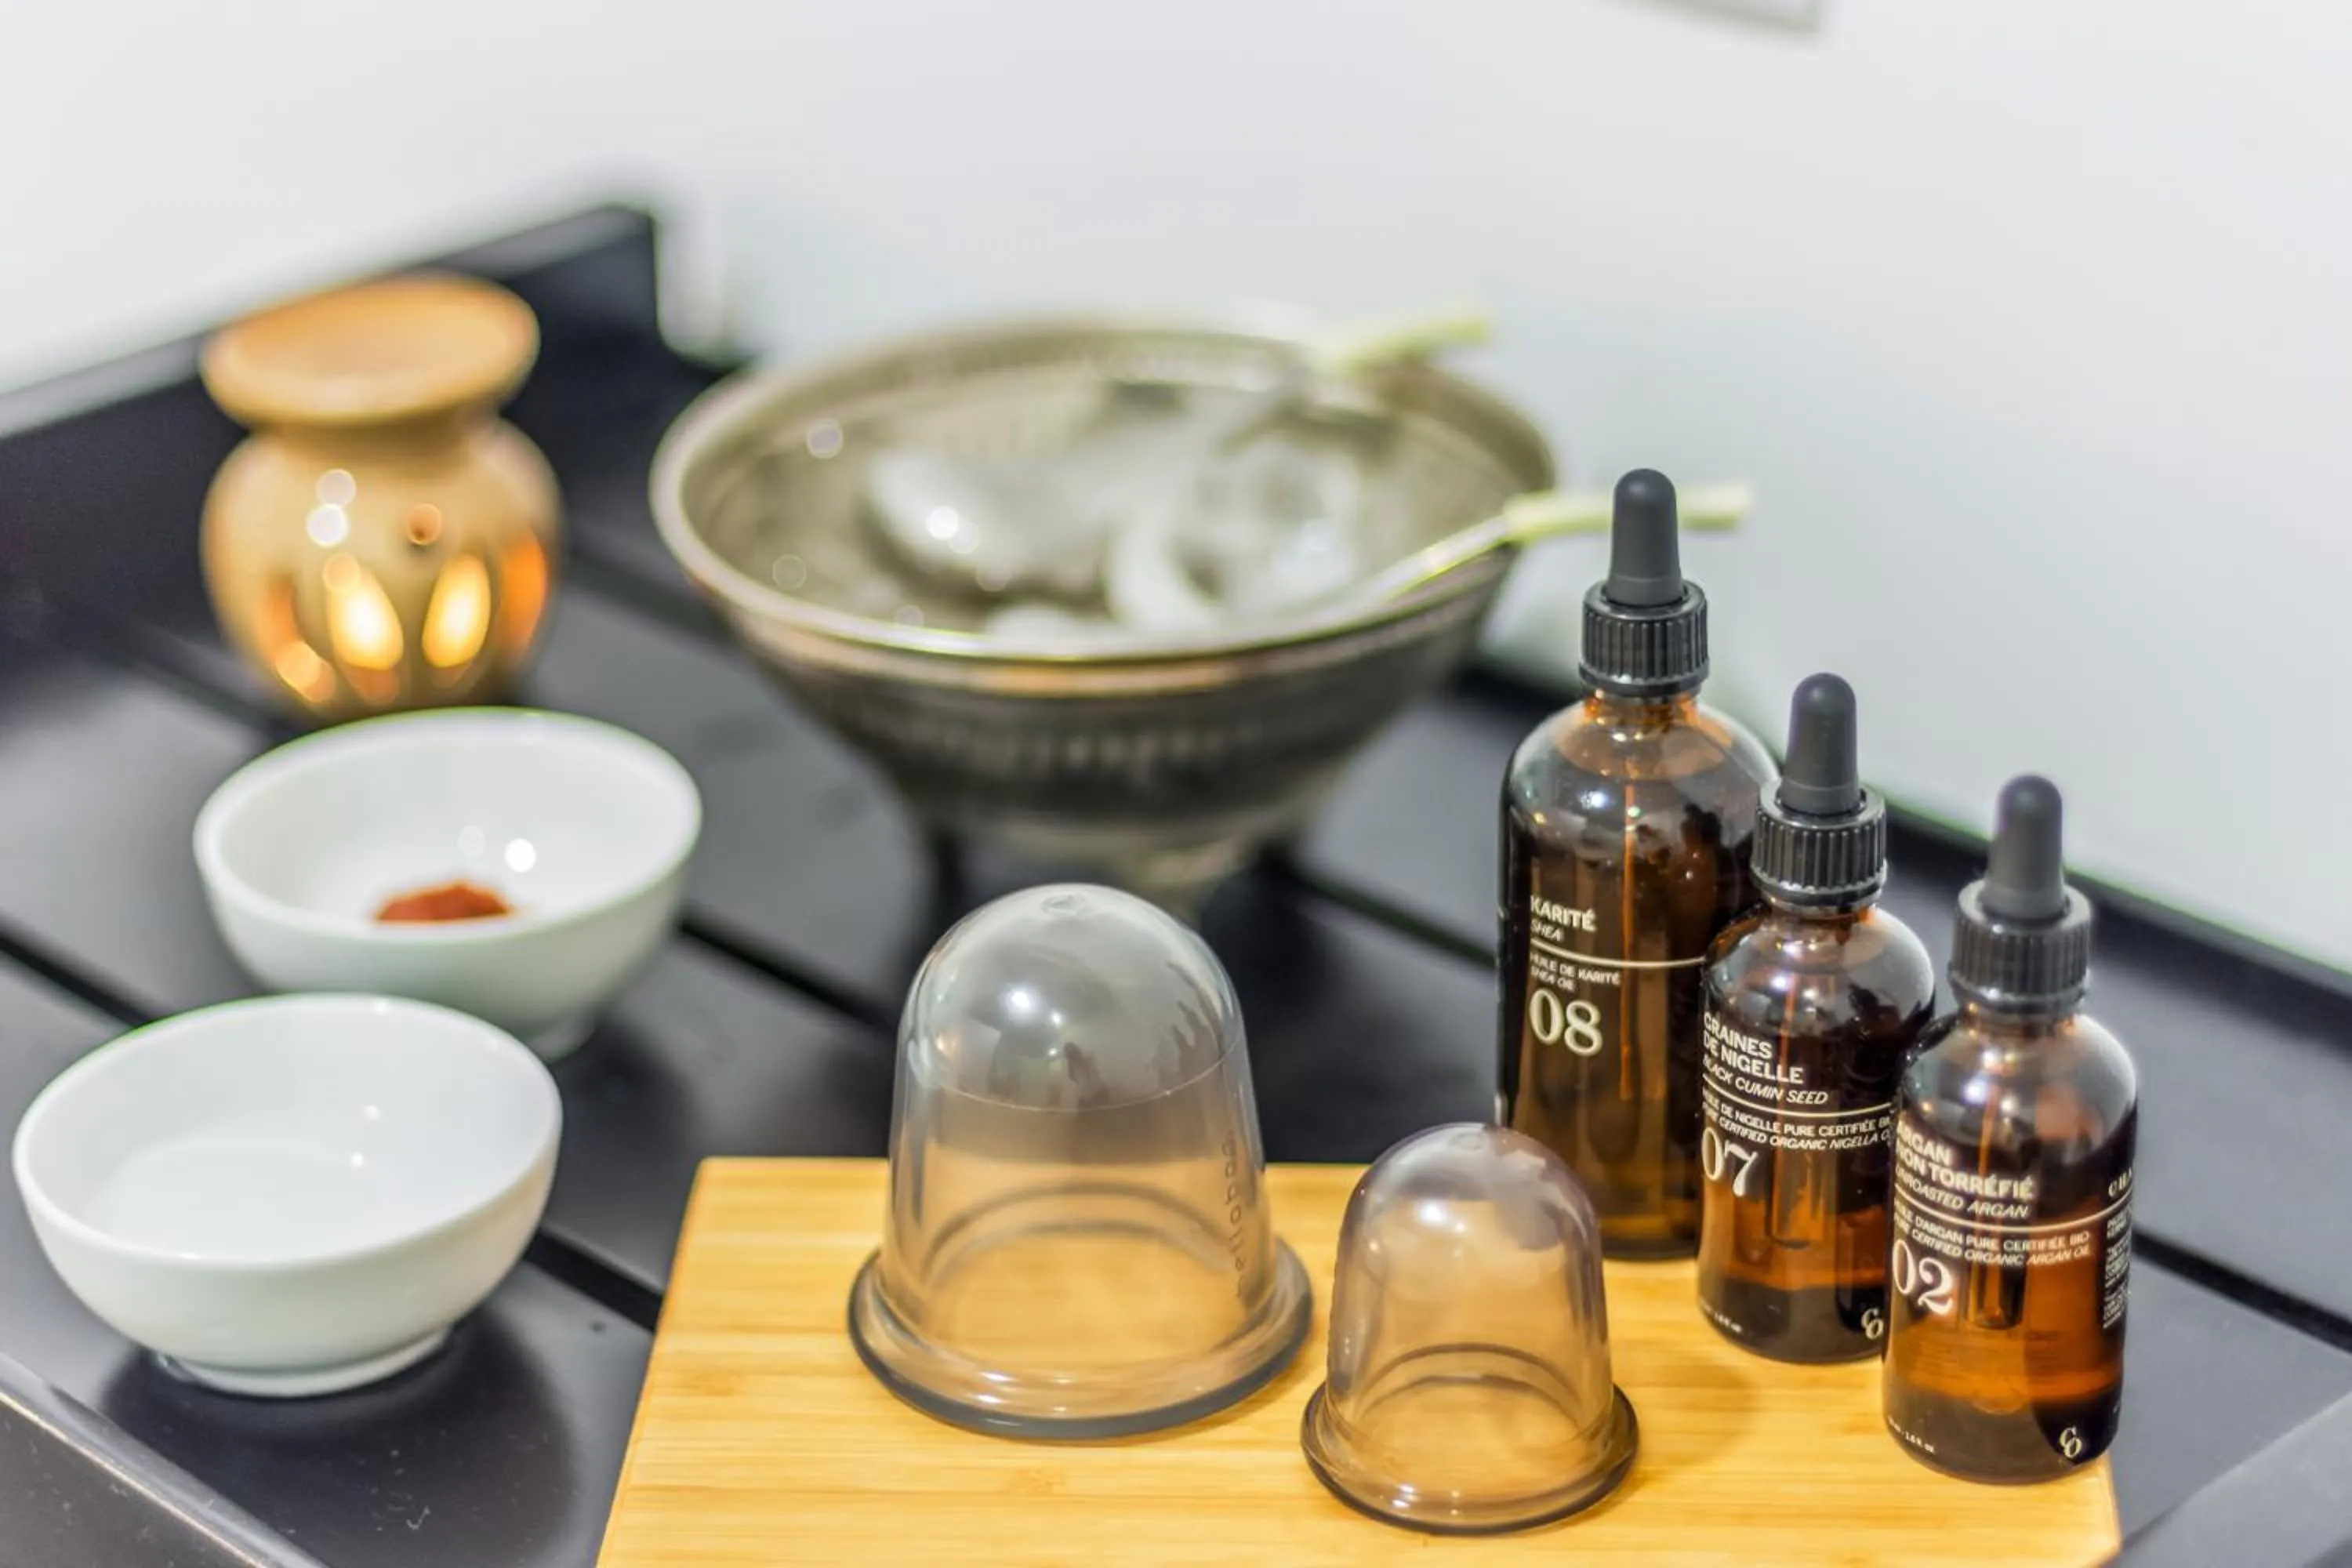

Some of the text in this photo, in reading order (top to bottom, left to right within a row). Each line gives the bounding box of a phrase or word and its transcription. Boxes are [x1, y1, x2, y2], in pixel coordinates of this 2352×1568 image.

[1530, 895, 1597, 932] KARITÉ
[1531, 919, 1563, 942] SHEA
[1559, 964, 1576, 978] DE
[1578, 969, 1621, 985] KARITÉ
[1530, 988, 1603, 1056] 08
[1704, 1011, 1773, 1058] GRAINES
[1704, 1031, 1804, 1083] DE NIGELLE
[1735, 1076, 1784, 1099] CUMIN
[1787, 1090, 1829, 1105] SEED
[1719, 1117, 1767, 1144] CERTIFIED
[1769, 1138, 1827, 1151] ORGANIC
[1830, 1131, 1878, 1150] NIGELLA
[1735, 1109, 1780, 1134] NIGELLE
[1784, 1123, 1815, 1138] PURE
[1701, 1127, 1758, 1197] 07
[1929, 1163, 2034, 1199] TORRÉFIÉ
[1967, 1200, 2029, 1219] ARGAN
[1964, 1249, 2024, 1266] ORGANIC
[2027, 1250, 2070, 1266] ARGAN
[1966, 1234, 1998, 1251] PURE
[1892, 1239, 1954, 1316] 02
